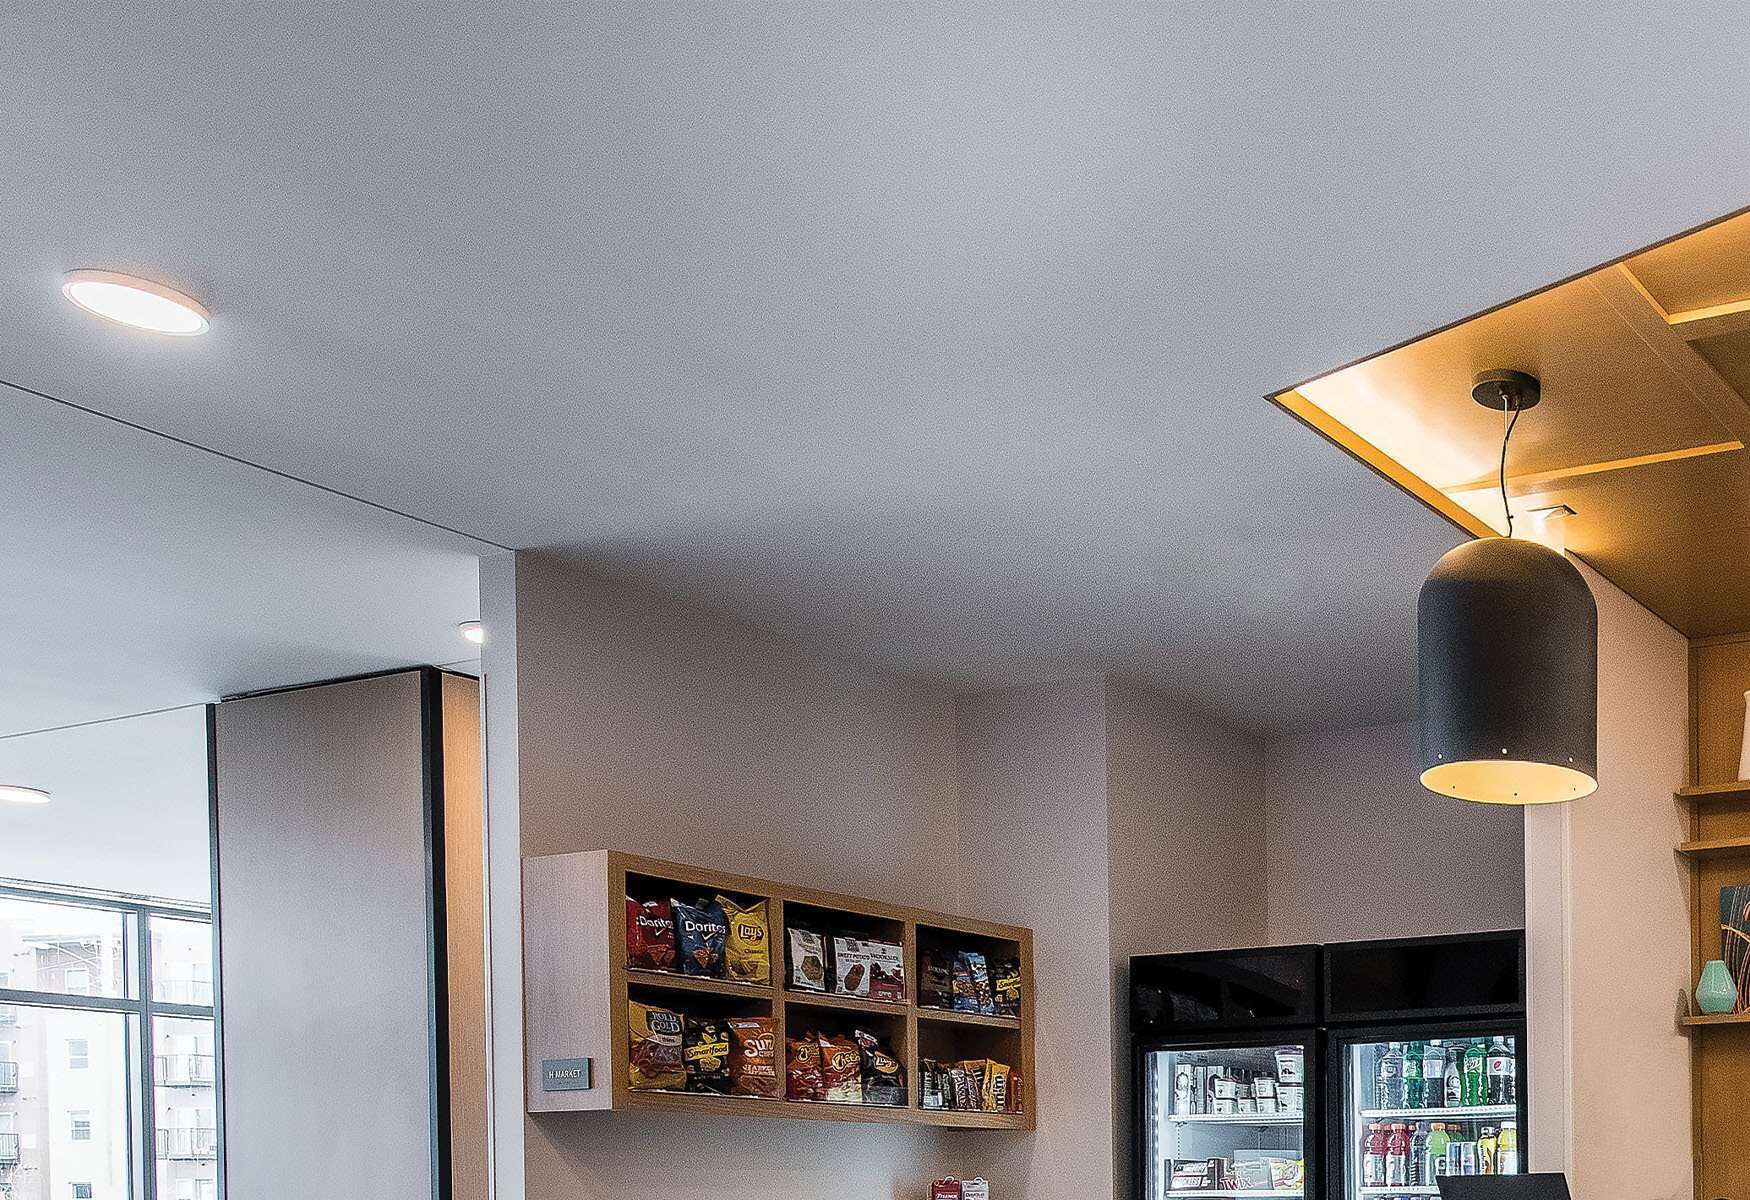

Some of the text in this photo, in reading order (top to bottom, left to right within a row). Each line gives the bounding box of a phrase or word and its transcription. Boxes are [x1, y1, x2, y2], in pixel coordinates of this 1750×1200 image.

[684, 920, 727, 934] Doritos
[650, 1020, 680, 1033] GOLD
[687, 1044, 728, 1058] Smartfood
[548, 1069, 581, 1079] H MARKET
